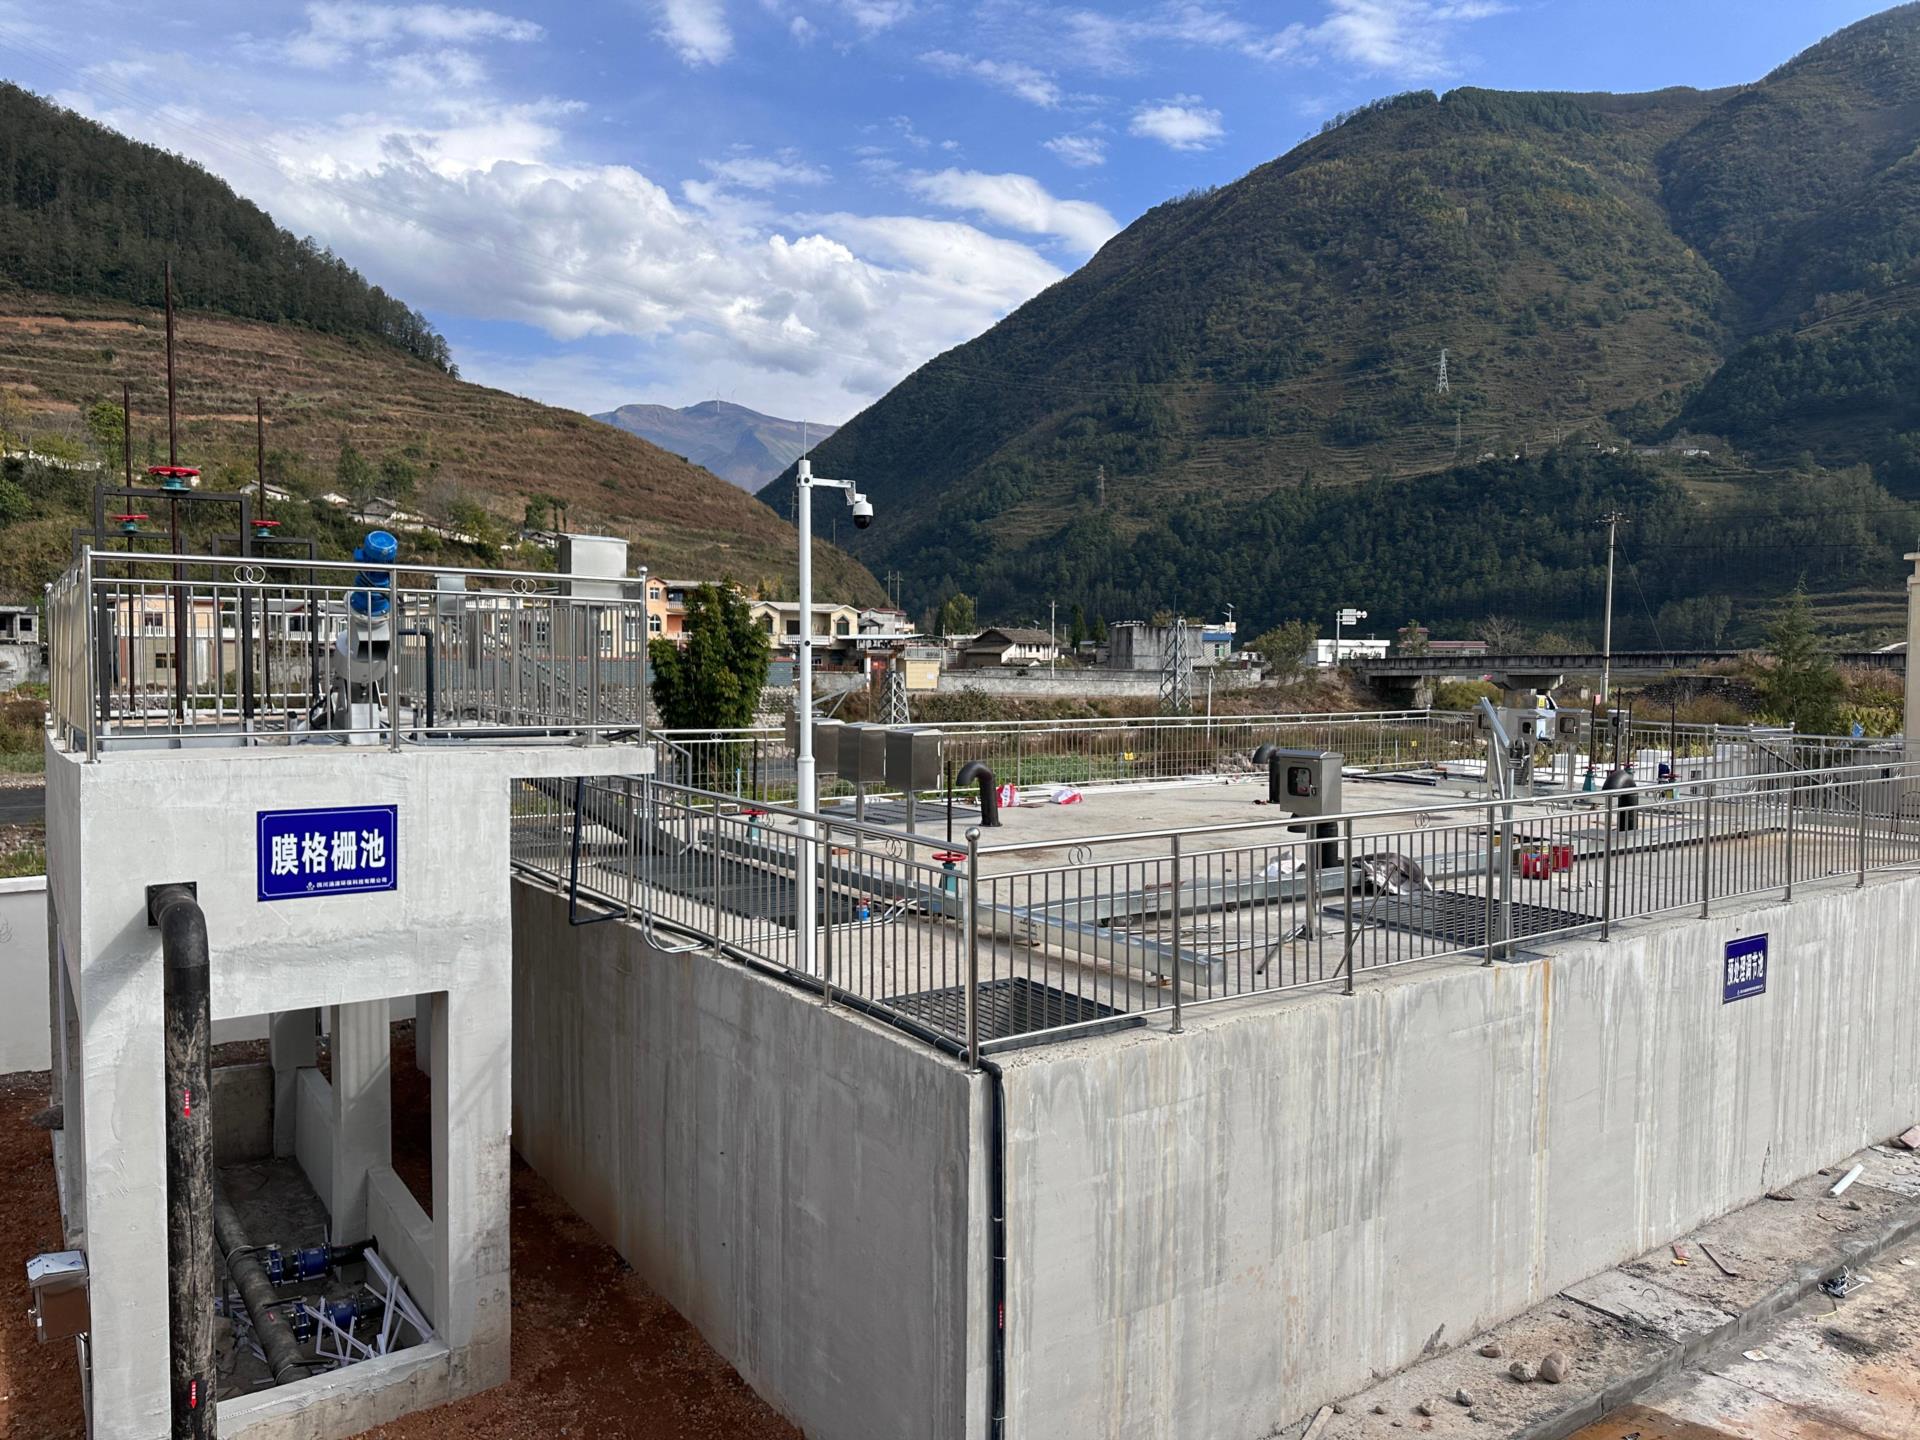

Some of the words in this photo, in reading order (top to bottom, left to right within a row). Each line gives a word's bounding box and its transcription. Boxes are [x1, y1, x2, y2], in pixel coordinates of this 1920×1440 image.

[271, 828, 386, 876] 膜格栅池
[1727, 950, 1764, 986] 预处理调节池
